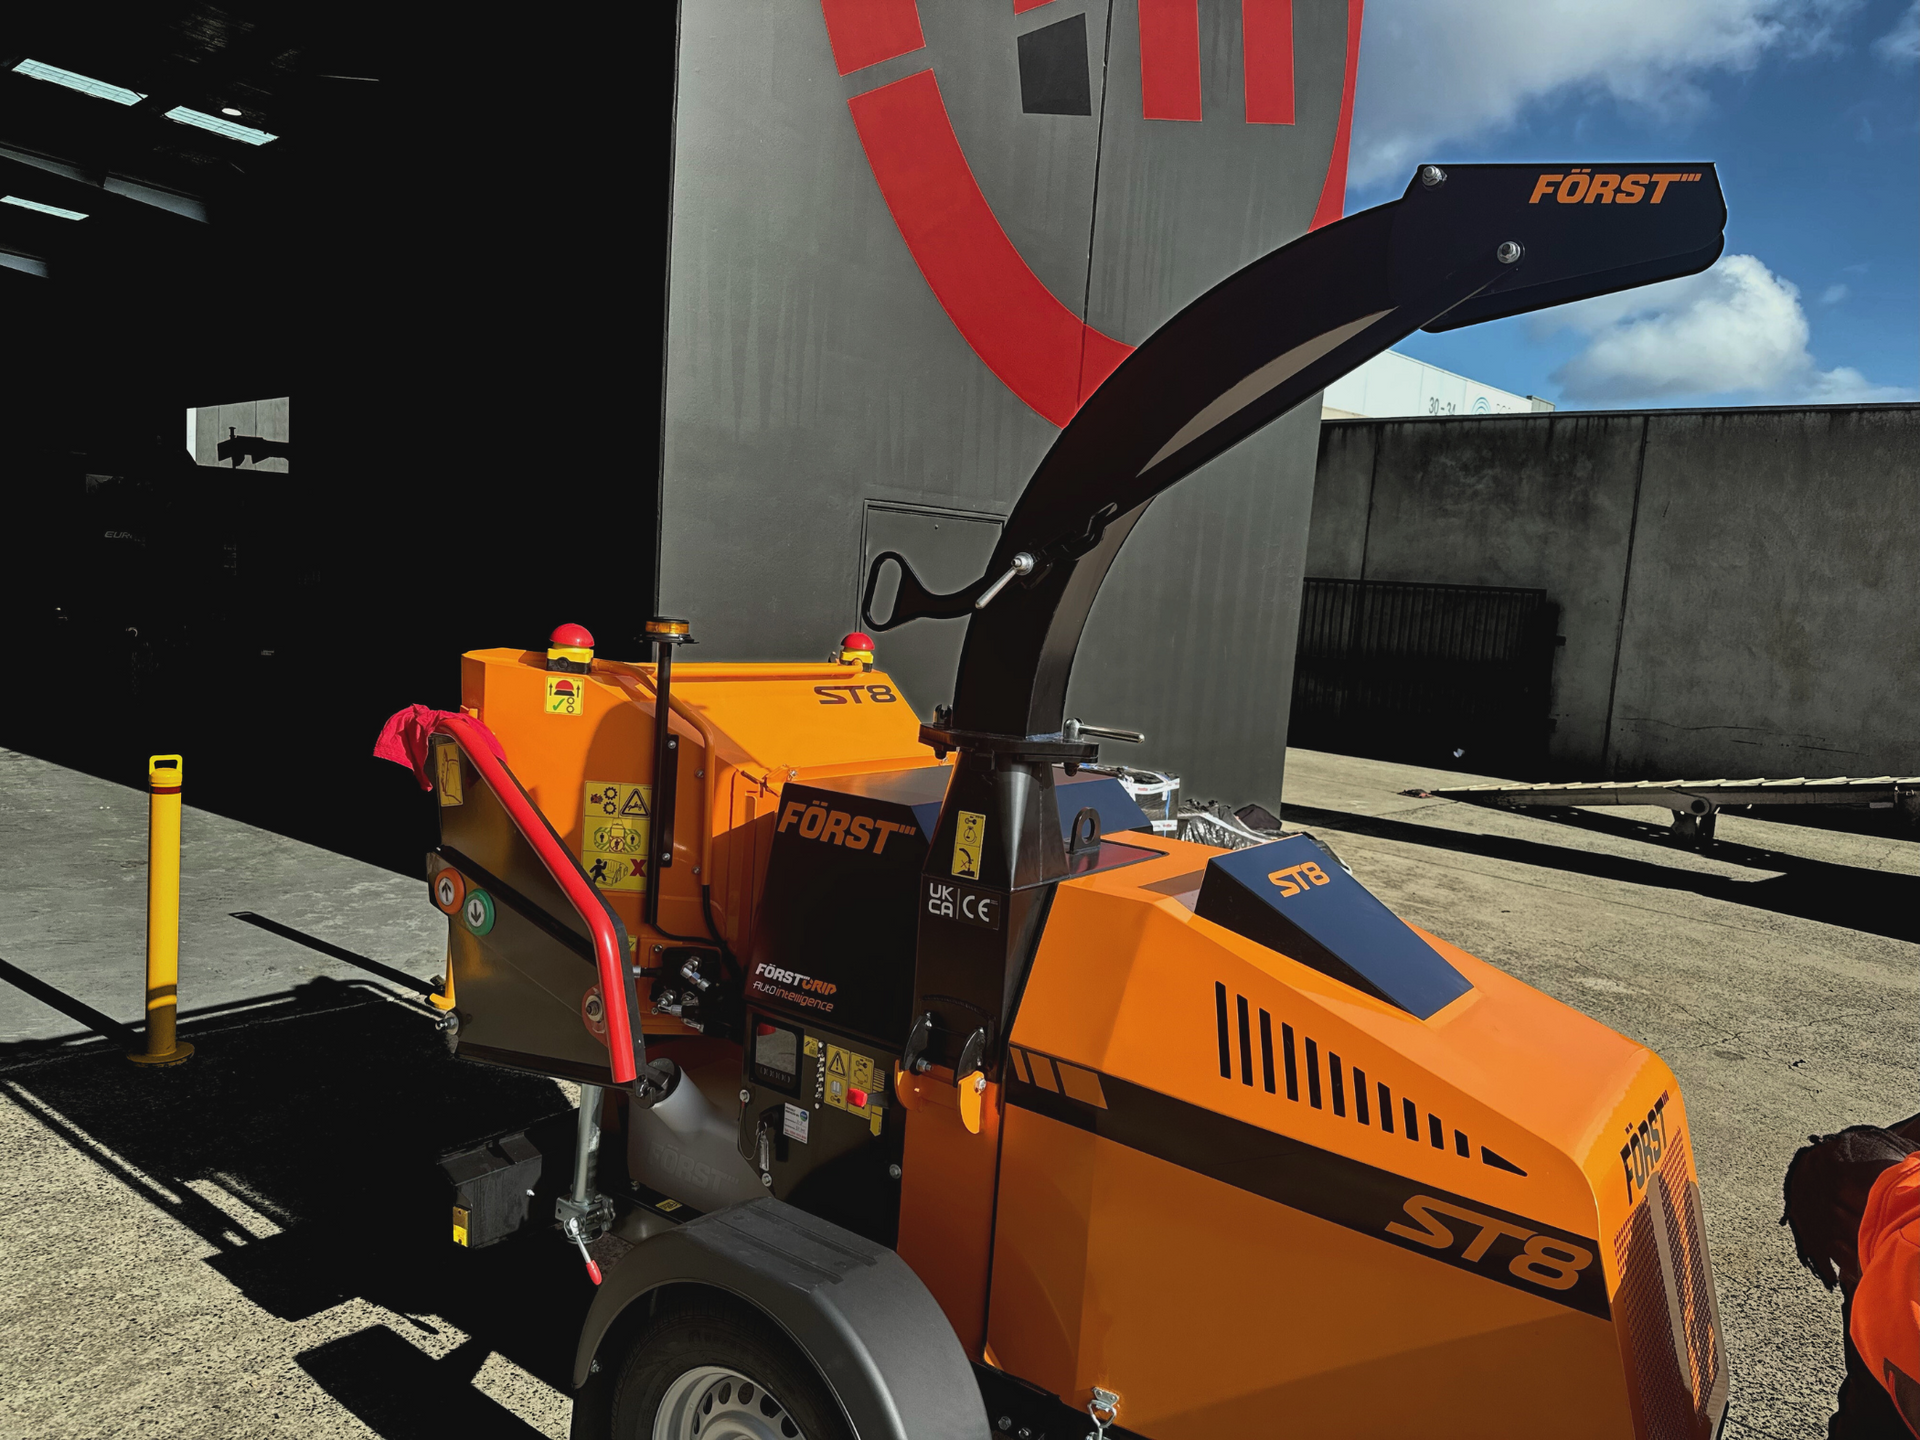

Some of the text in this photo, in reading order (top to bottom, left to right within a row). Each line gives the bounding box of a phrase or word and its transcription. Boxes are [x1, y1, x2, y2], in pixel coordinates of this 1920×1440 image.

[1528, 168, 1702, 204] FÖRST
[813, 684, 897, 705] ST8
[777, 800, 916, 854] FÖRST
[929, 882, 955, 902] UK
[1267, 861, 1331, 898] ST8
[928, 899, 954, 918] CA
[775, 985, 834, 1013] intelligence
[1619, 1089, 1670, 1207] FÖRST
[1384, 1194, 1594, 1291] ST8
